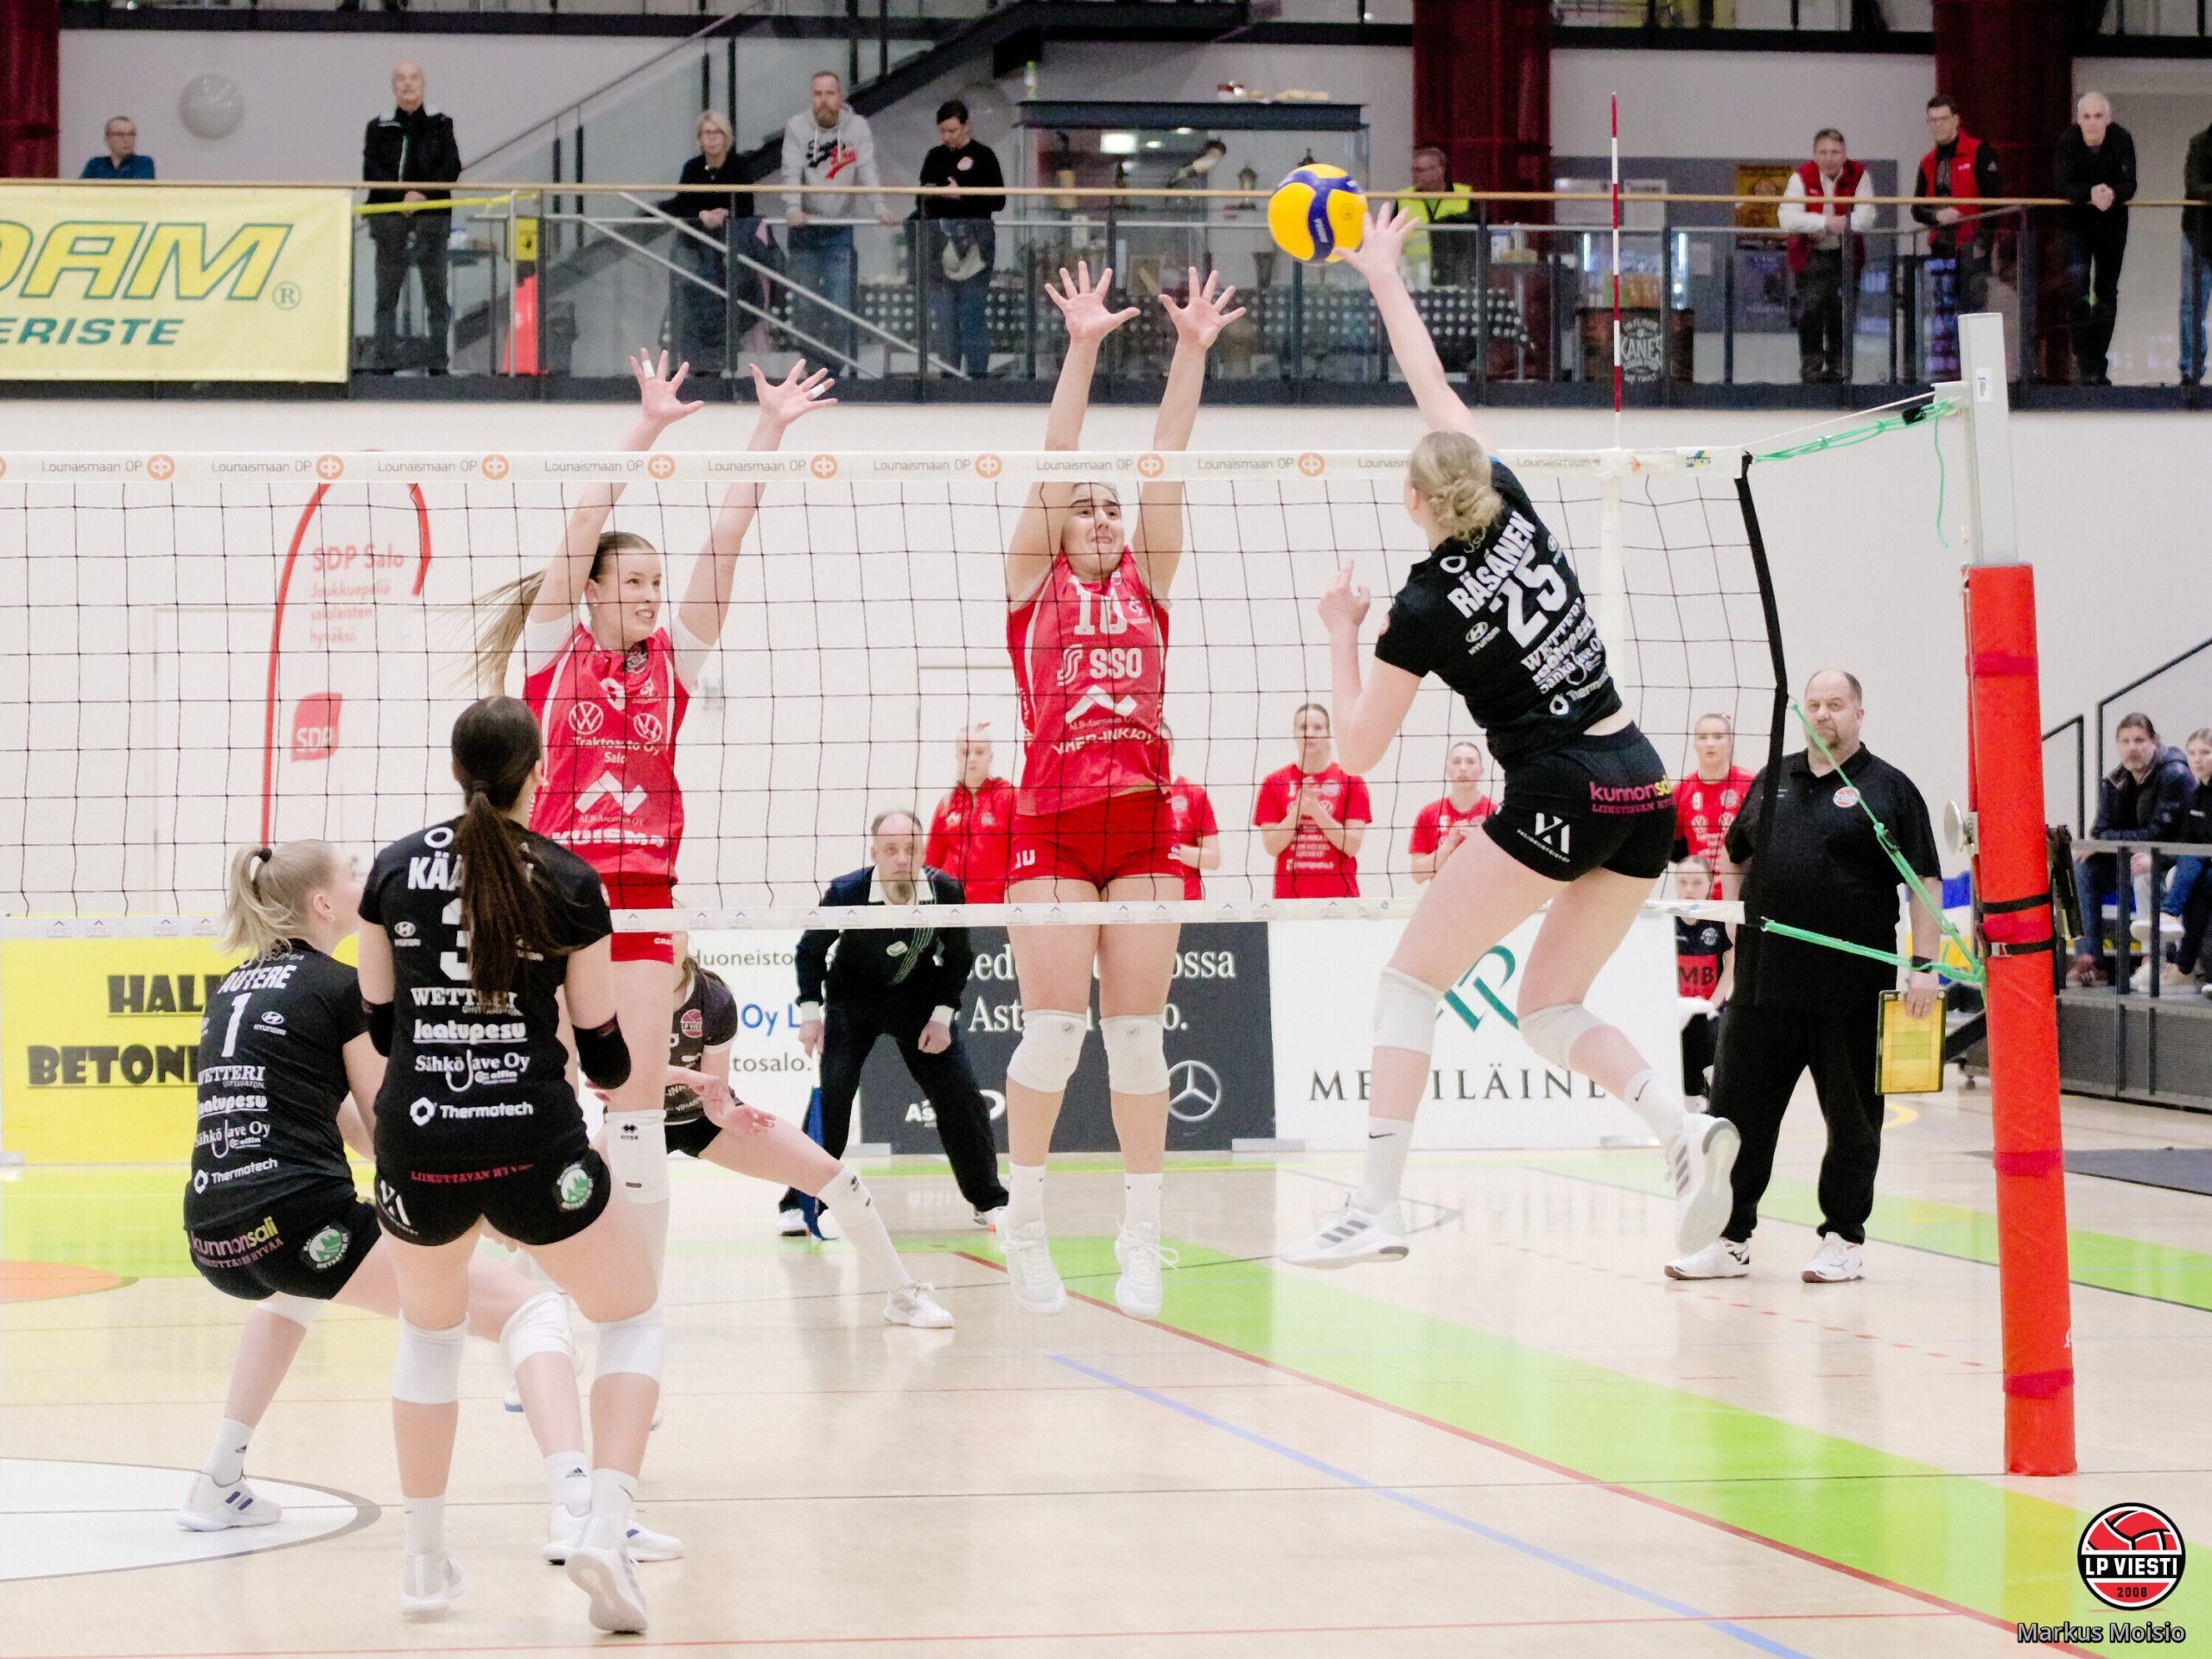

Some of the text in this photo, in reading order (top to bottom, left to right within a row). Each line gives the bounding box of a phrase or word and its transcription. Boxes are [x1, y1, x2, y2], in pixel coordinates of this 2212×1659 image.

[41, 460, 143, 472] Lounaismaan OP
[211, 460, 312, 472] Lounaismaan OP
[378, 460, 477, 471] Lounaismaan OP
[544, 459, 643, 471] Lounaismaan OP
[708, 459, 806, 470] Lounaismaan OP
[873, 459, 970, 470] Lounaismaan OP
[1036, 458, 1133, 469] Lounaismaan OP
[1198, 457, 1294, 468] Lounaismaan OP
[312, 543, 404, 571] SDP Salo
[1489, 543, 1567, 648] 25
[1090, 647, 1142, 679] SSO
[296, 727, 334, 753] SDP
[217, 965, 297, 994] AUTERE
[221, 993, 252, 1058] 1
[741, 1003, 778, 1037] Oy
[504, 1052, 531, 1073] Oy
[440, 1102, 534, 1119] Thermotech
[249, 1121, 270, 1138] Oy
[212, 1158, 278, 1185] Thermotech
[191, 1216, 278, 1256] kunnonsali
